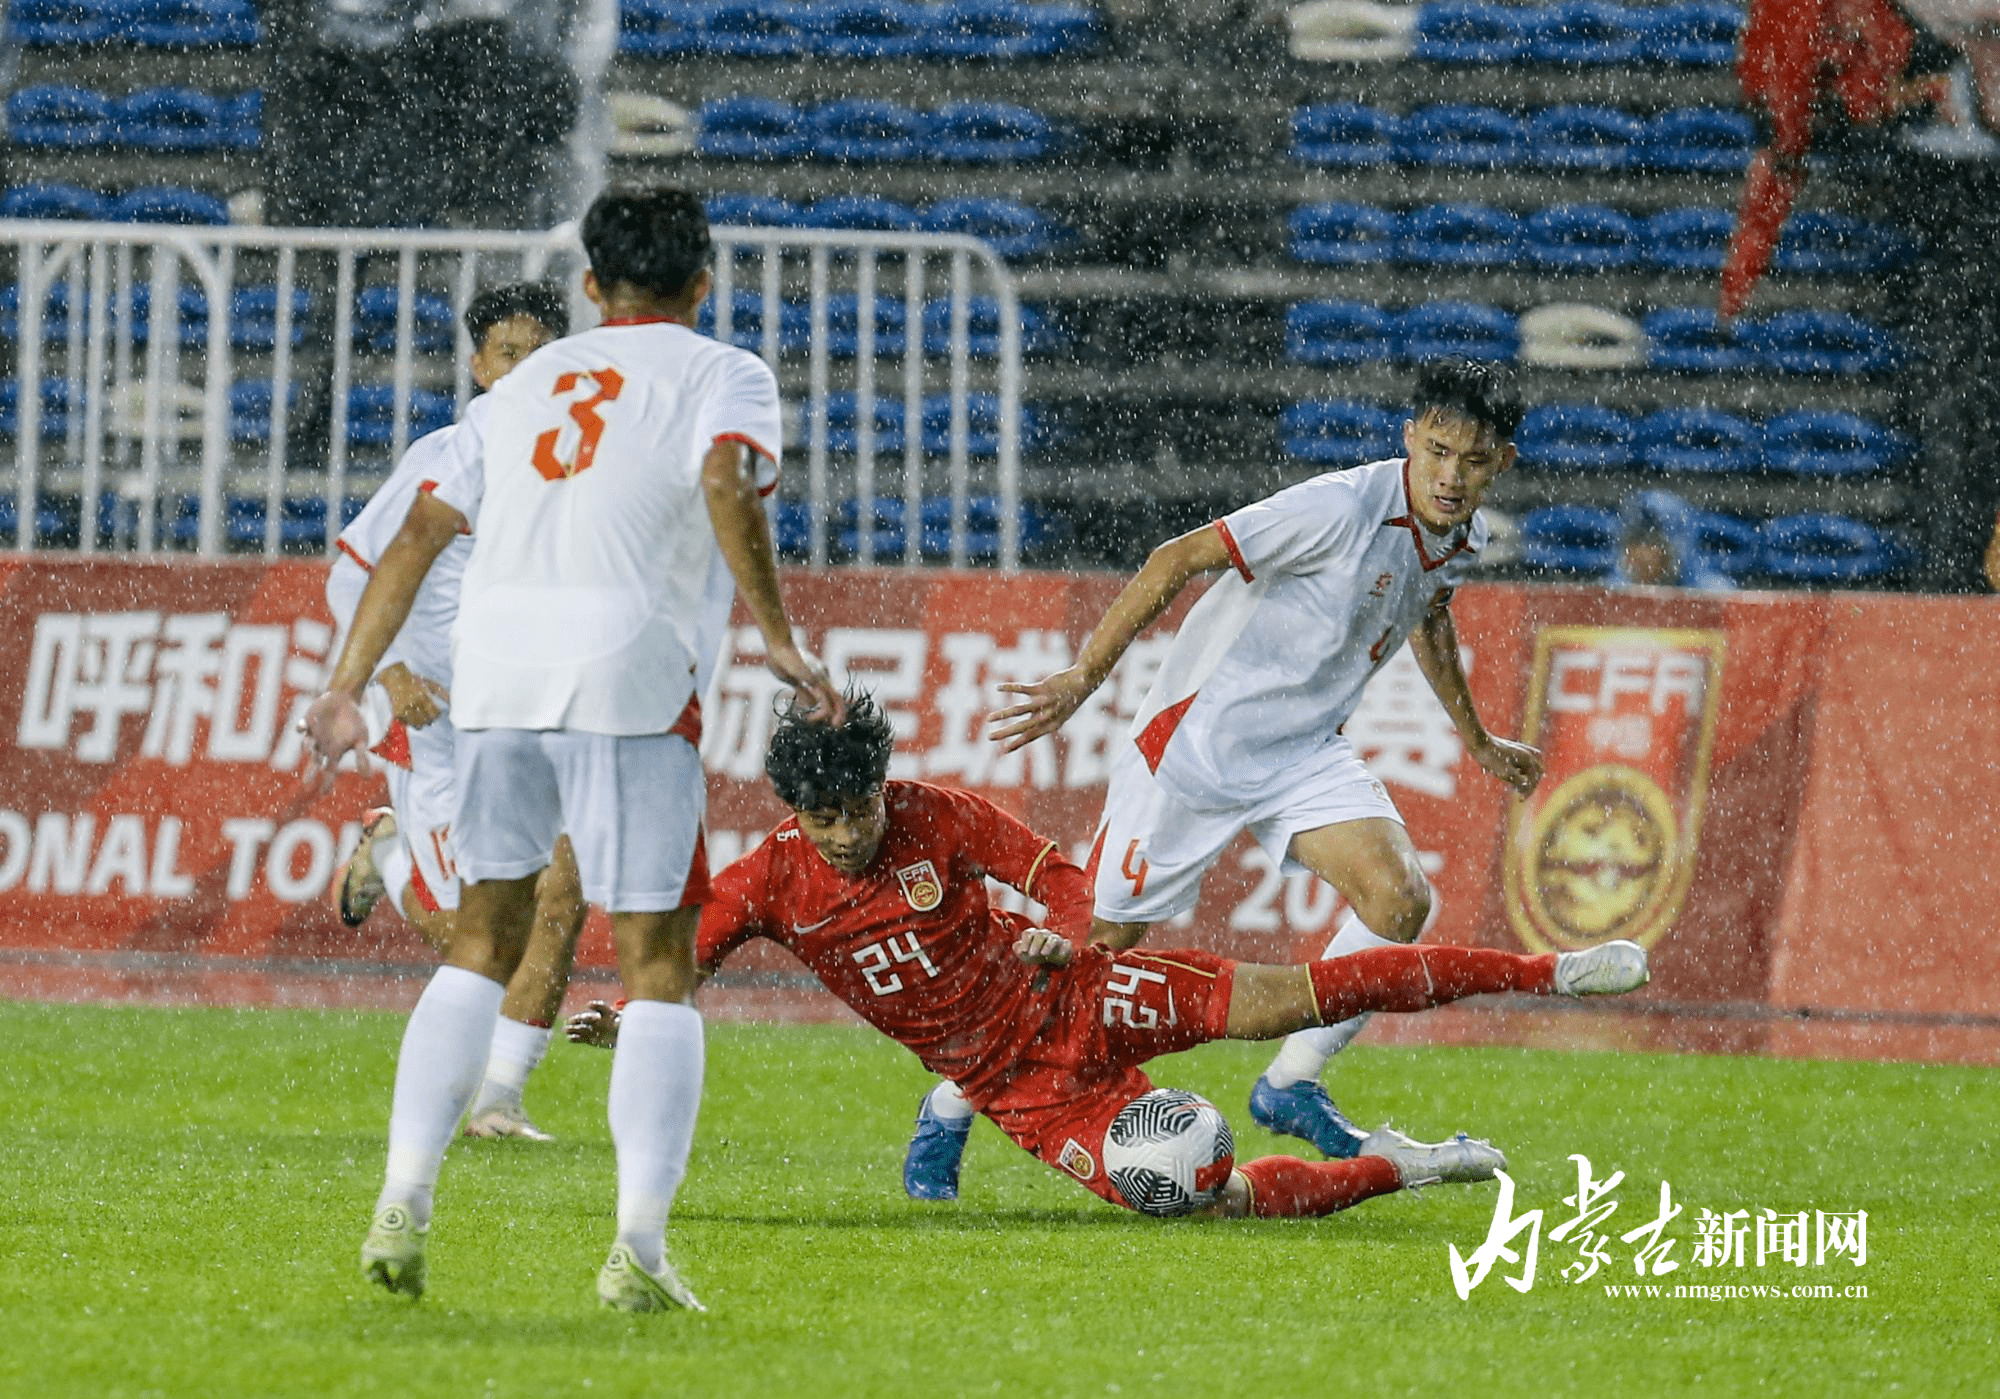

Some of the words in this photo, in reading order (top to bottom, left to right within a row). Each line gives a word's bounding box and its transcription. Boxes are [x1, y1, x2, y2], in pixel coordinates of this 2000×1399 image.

[531, 367, 625, 481] 3
[1547, 650, 1704, 716] CFA
[1122, 838, 1149, 897] 4
[852, 931, 938, 996] 24
[1103, 964, 1167, 1030] 24
